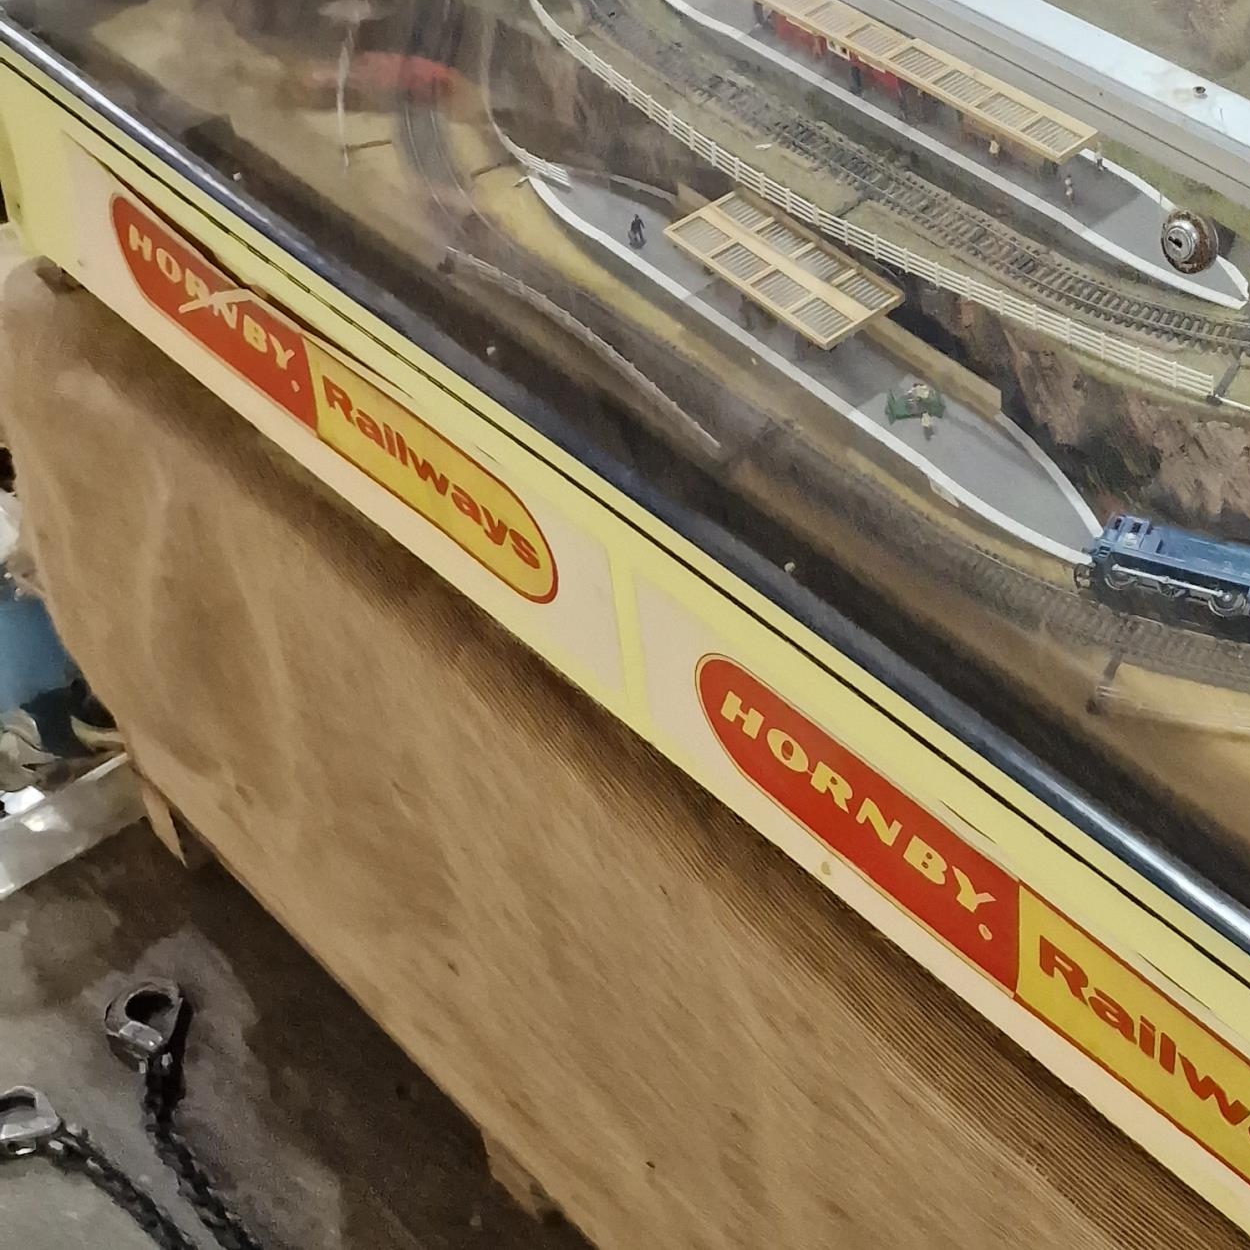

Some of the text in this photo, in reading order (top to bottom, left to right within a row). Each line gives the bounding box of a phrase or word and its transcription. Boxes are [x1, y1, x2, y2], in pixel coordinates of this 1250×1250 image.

[128, 223, 540, 570] HORNBY Railways
[719, 689, 997, 914] HORNBY
